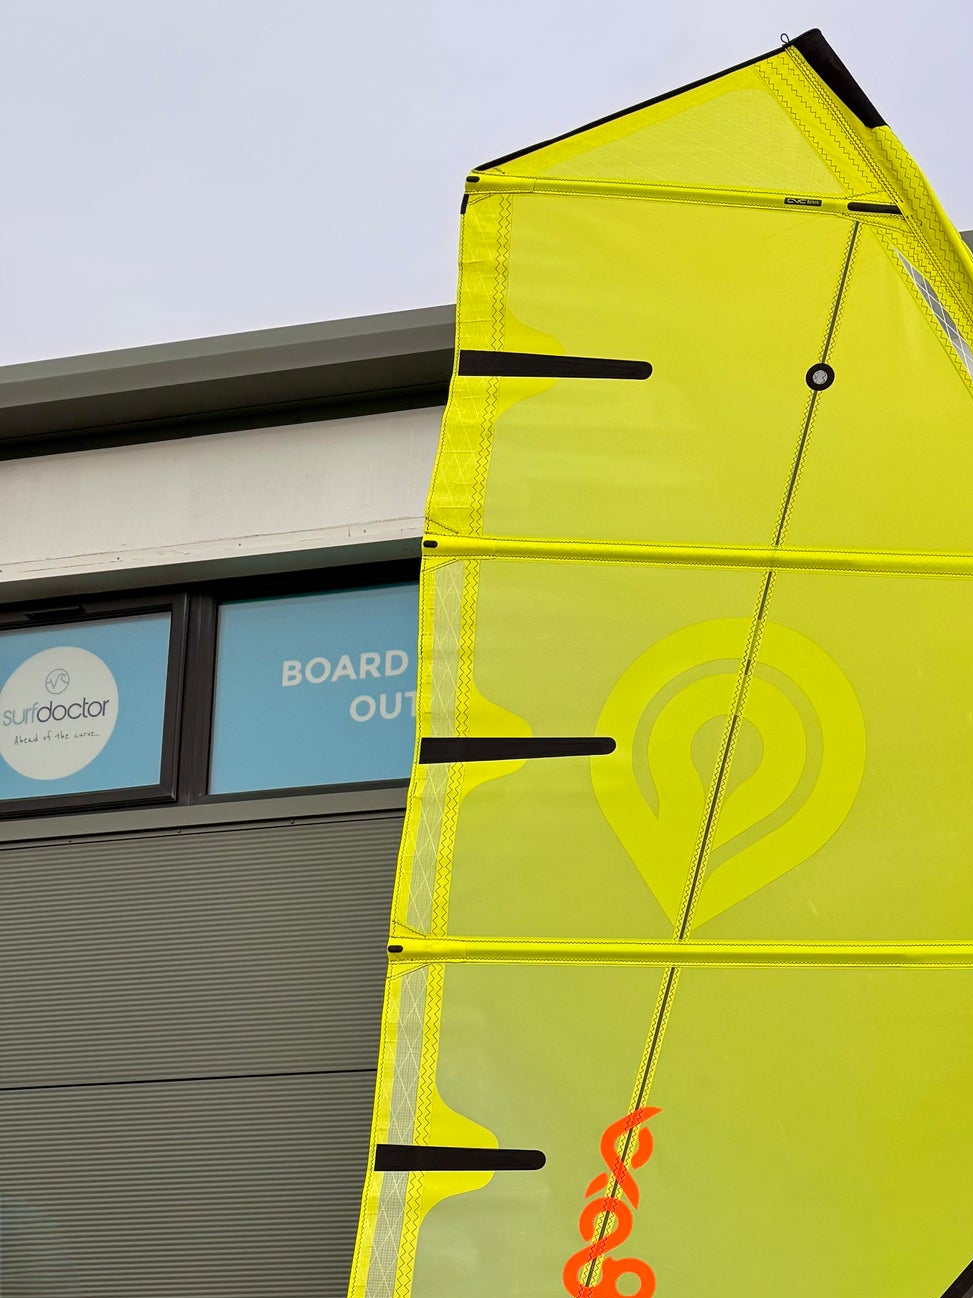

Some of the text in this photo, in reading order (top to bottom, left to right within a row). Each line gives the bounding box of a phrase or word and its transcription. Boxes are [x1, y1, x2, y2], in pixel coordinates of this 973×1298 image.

[281, 649, 409, 687] BOARD
[3, 697, 110, 726] surfdoctor
[350, 691, 417, 722] OUT
[14, 733, 39, 746] Ahead
[43, 730, 52, 742] of
[55, 731, 69, 741] the
